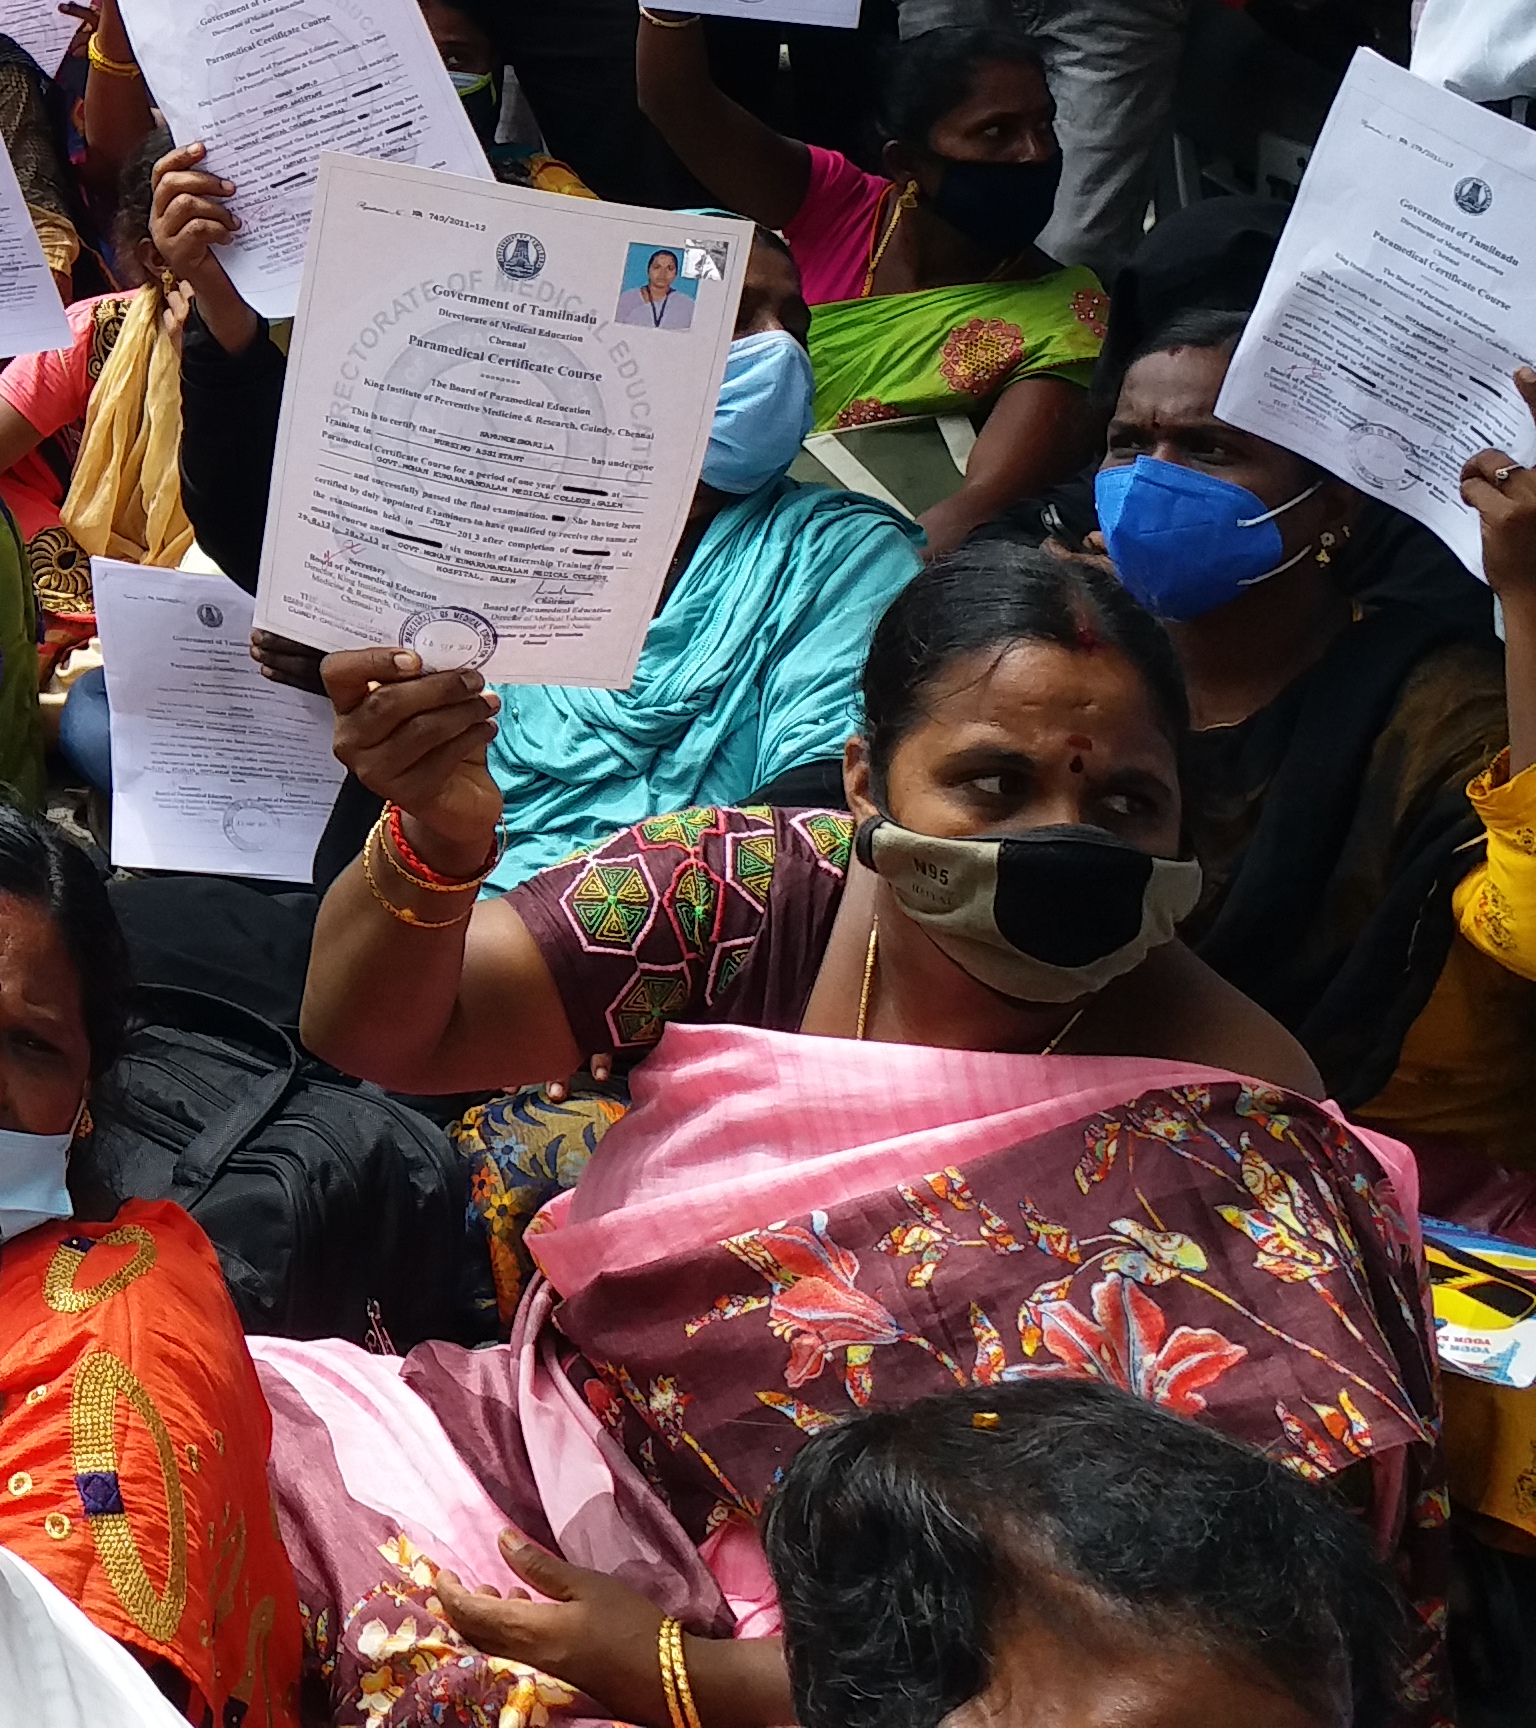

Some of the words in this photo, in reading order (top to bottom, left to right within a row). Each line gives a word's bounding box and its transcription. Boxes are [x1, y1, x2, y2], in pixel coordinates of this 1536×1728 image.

[1399, 198, 1456, 233] Government
[1457, 231, 1469, 241] of
[1372, 230, 1428, 266] Paramedical
[1429, 261, 1476, 293] Certificate
[1478, 287, 1512, 311] Course
[430, 283, 511, 310] Government
[512, 301, 526, 313] of
[527, 303, 598, 325] Tamilnadu
[437, 308, 488, 326] Directorate
[489, 319, 499, 328] of
[500, 321, 536, 335] Medical
[537, 328, 583, 343] Education
[407, 334, 486, 361] Paramedical
[486, 352, 555, 374] Certificate
[556, 364, 603, 382] Course
[487, 335, 526, 350] Chennai
[362, 378, 385, 392] King
[385, 383, 422, 399] Institute
[423, 392, 433, 401] of
[433, 396, 481, 413] Preventive
[481, 405, 523, 421] Medicine
[524, 413, 533, 422] &
[535, 416, 579, 431] Research,
[579, 422, 616, 437] Guindy,
[617, 426, 655, 441] Chennai
[429, 378, 447, 389] The
[448, 383, 476, 395] Board
[477, 388, 488, 398] of
[489, 391, 544, 408] Paramedical
[546, 401, 591, 416] Education
[320, 430, 373, 450] Paramedical
[372, 444, 419, 463] Certificate
[419, 456, 452, 471] Course
[452, 463, 466, 474] for
[475, 470, 505, 483] period
[506, 475, 518, 483] of
[517, 478, 534, 487] one
[535, 481, 555, 491] year
[323, 415, 360, 432] Training
[363, 425, 372, 434] in
[432, 436, 472, 453] NURSING
[474, 447, 525, 463] ASSISTANT
[350, 406, 369, 417] This
[370, 411, 378, 420] is
[379, 414, 388, 422] to
[389, 417, 417, 432] certify
[418, 424, 436, 435] that
[590, 456, 606, 466] has
[607, 458, 654, 474] undergone
[353, 471, 369, 481] and
[370, 476, 420, 496] successfully
[421, 490, 451, 503] passed
[452, 497, 468, 506] the
[469, 500, 490, 511] final
[492, 505, 549, 521] examination.
[571, 516, 589, 526] She
[590, 517, 619, 530] having
[621, 520, 641, 531] been
[913, 857, 950, 886] N95
